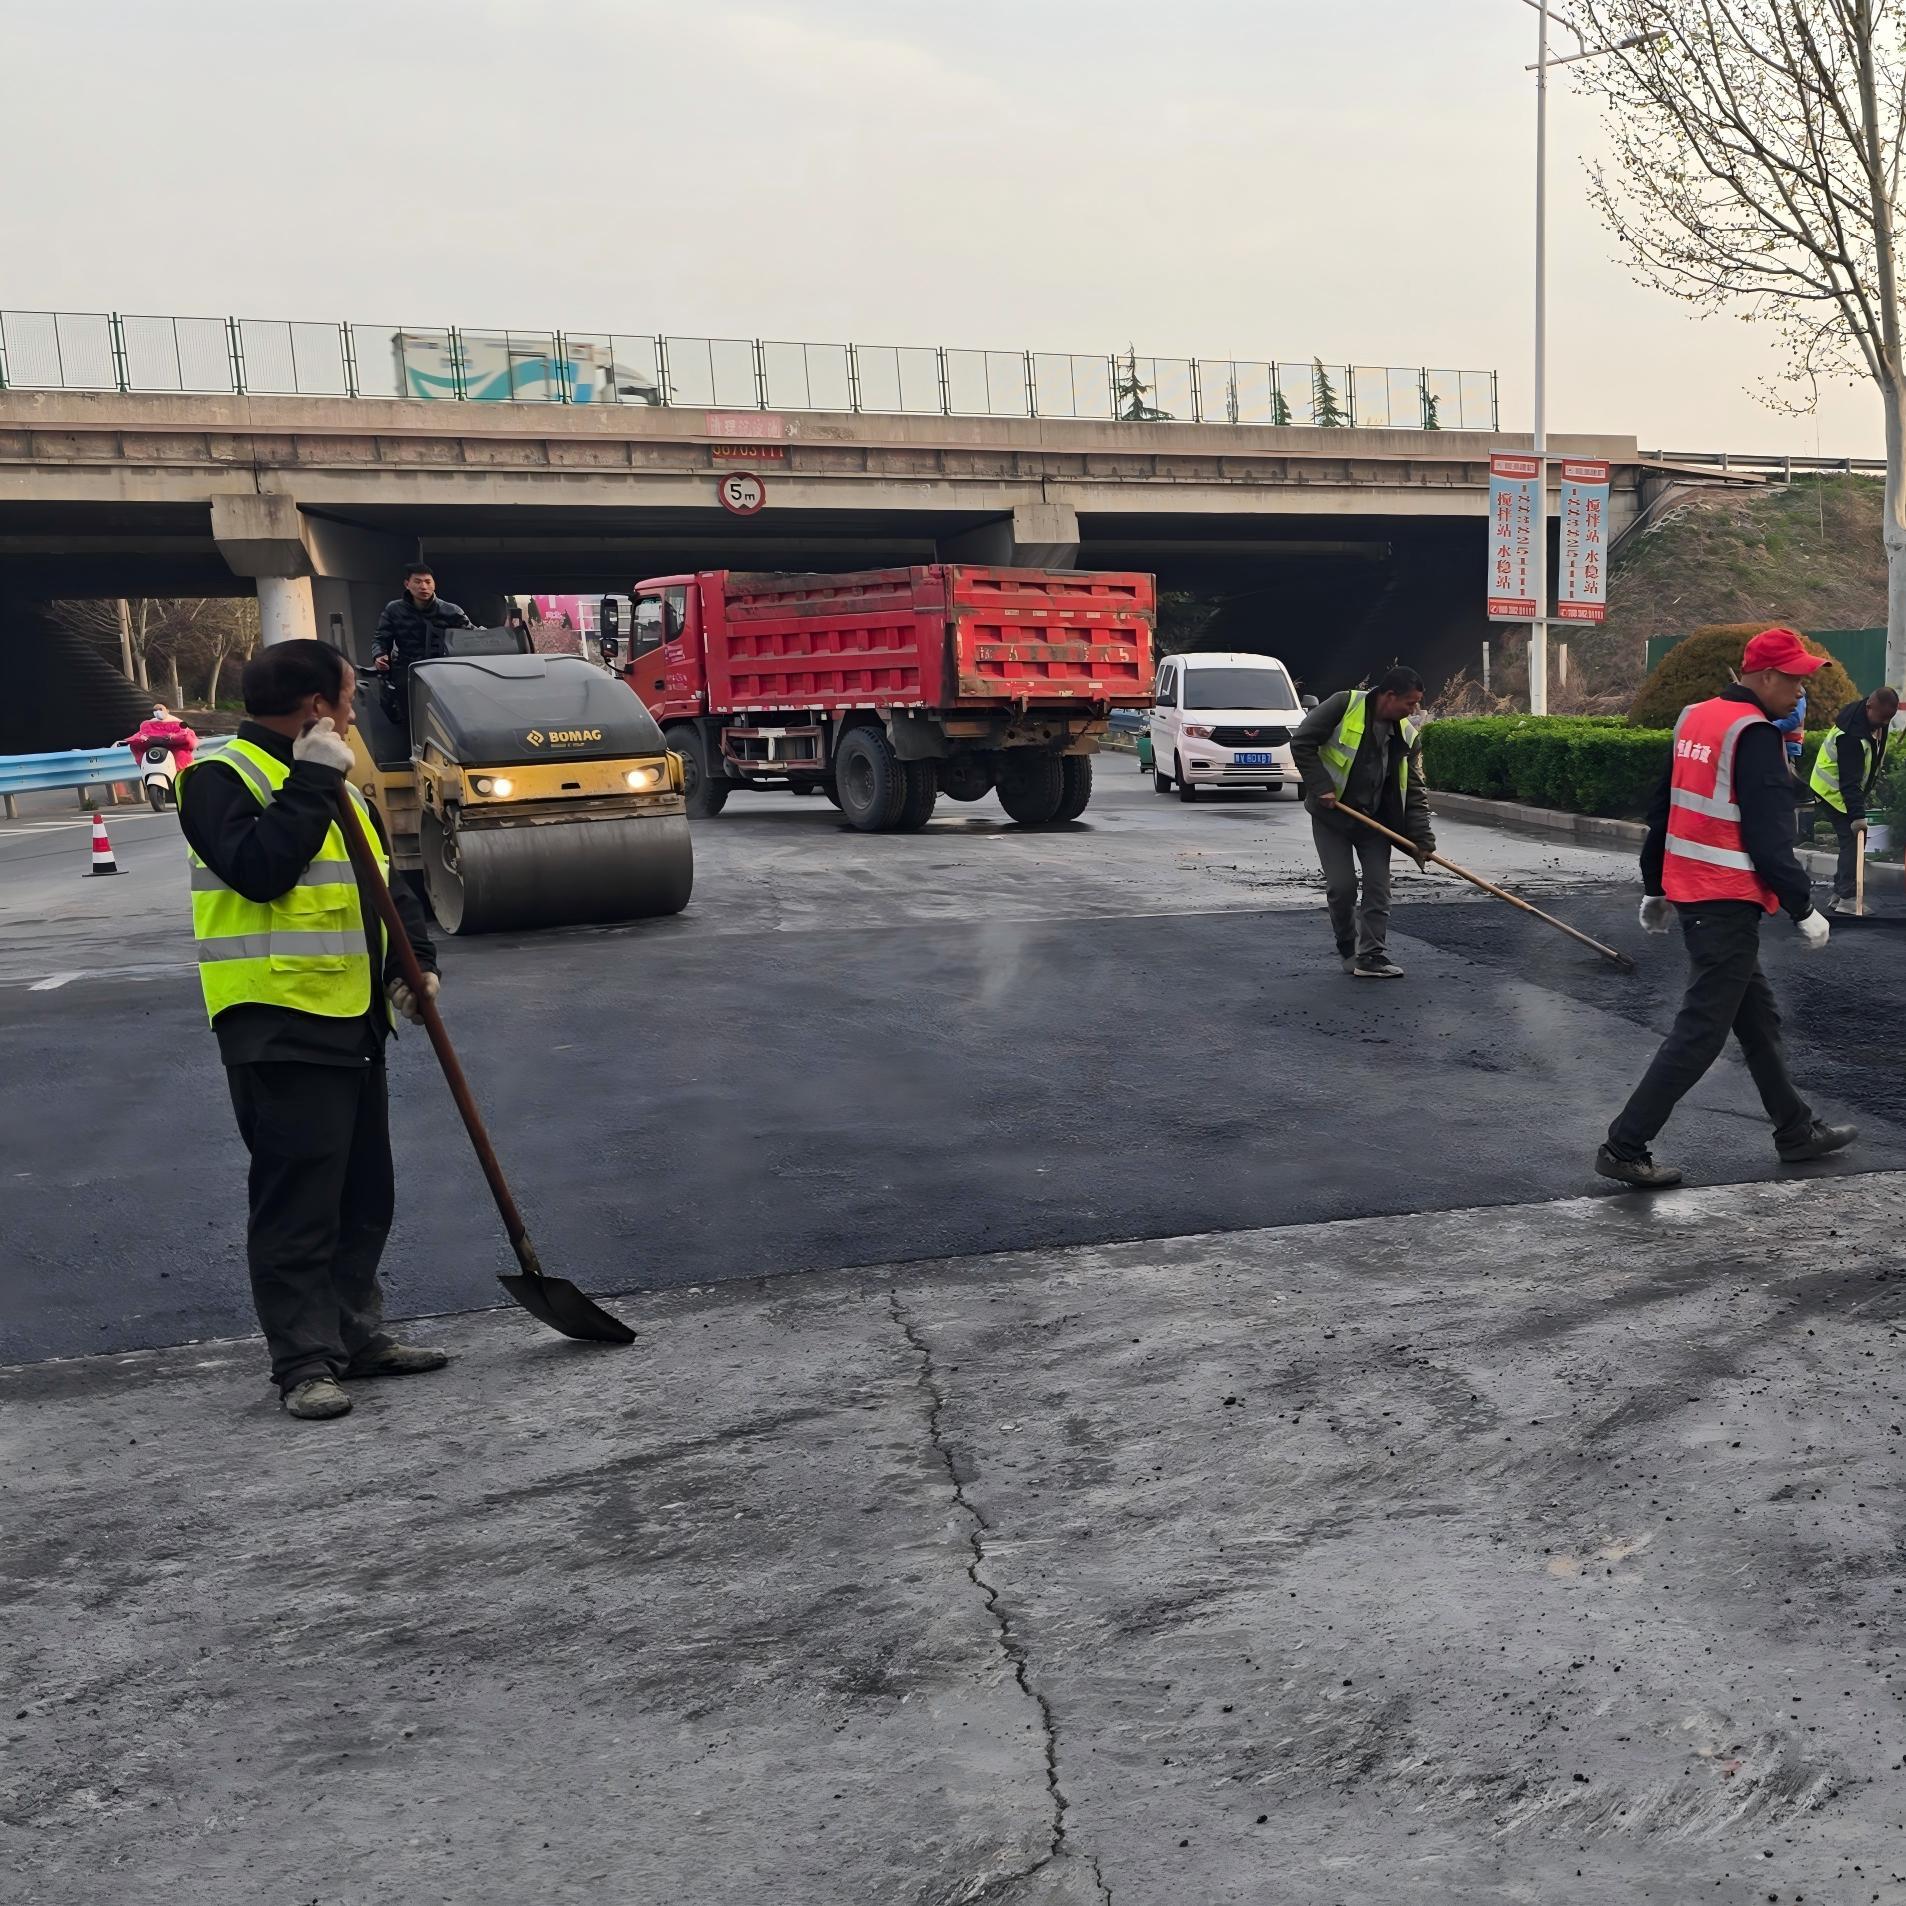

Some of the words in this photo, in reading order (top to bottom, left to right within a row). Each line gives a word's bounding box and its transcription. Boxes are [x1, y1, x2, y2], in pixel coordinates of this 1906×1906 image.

[730, 484, 755, 501] 5m
[1497, 492, 1513, 538] 搅拌站
[1516, 484, 1531, 596] 18838251111
[1566, 488, 1581, 599] 18838251111
[1585, 498, 1601, 544] 搅拌站
[1496, 545, 1512, 589] 水稳站
[1583, 549, 1600, 595] 水稳站
[548, 729, 602, 743] BOMAG
